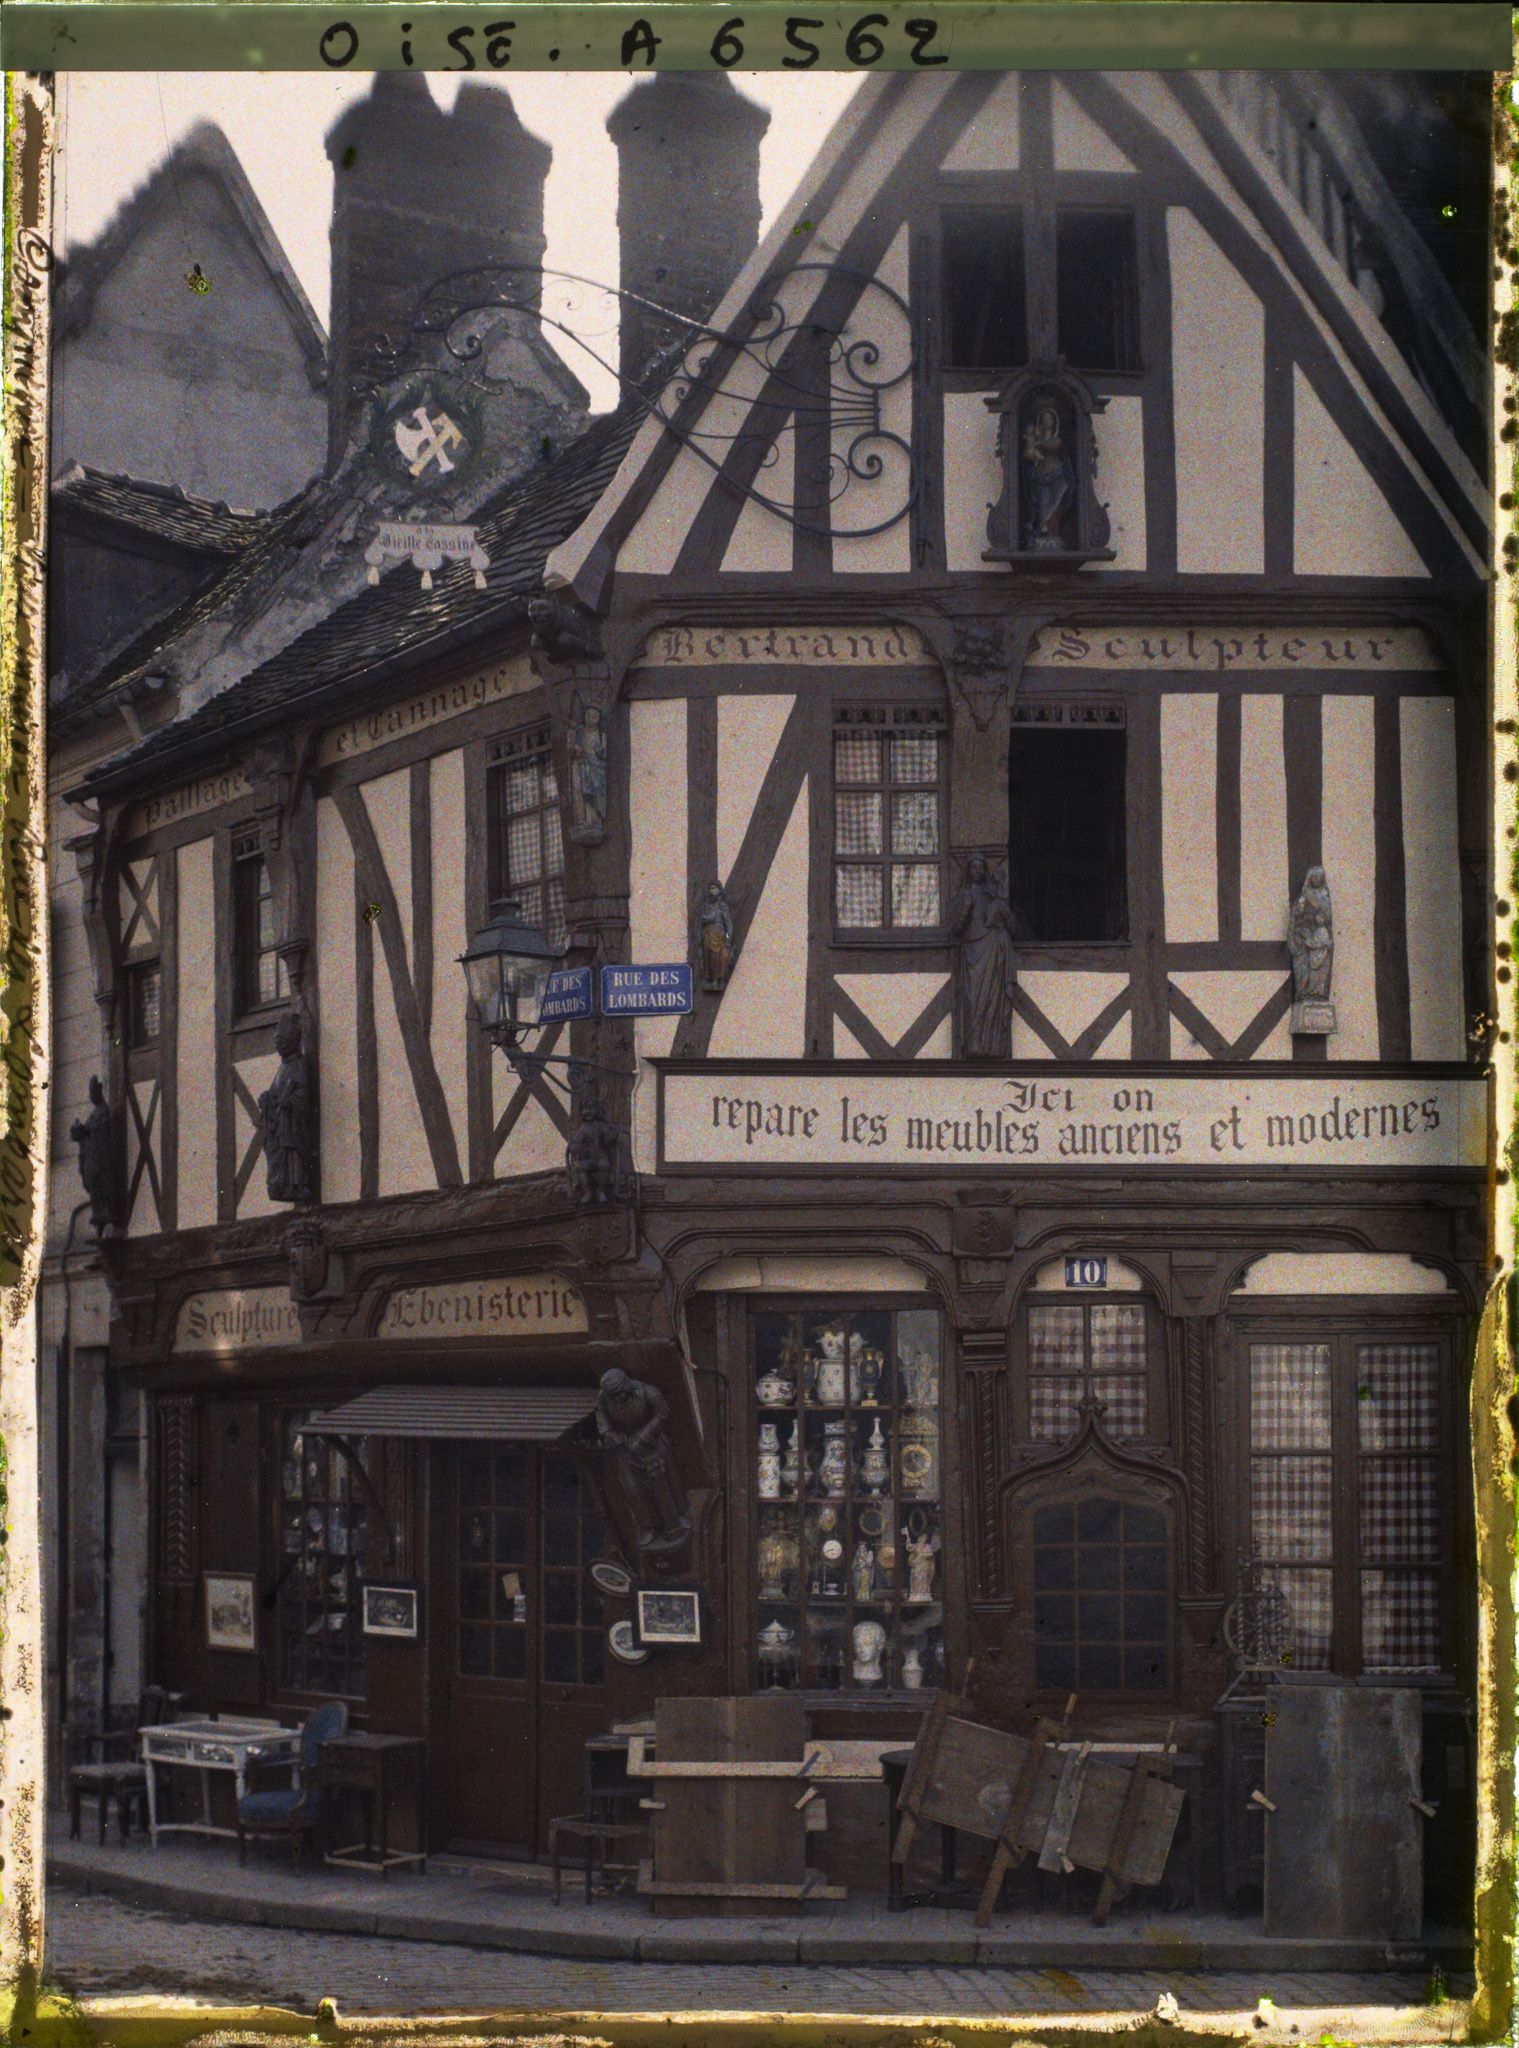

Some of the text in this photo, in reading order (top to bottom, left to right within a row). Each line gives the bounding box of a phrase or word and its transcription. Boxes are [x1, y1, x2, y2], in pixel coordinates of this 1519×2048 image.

[662, 626, 909, 663] Bertrand
[1051, 624, 1395, 669] Sculpteur
[335, 721, 359, 754] et
[562, 974, 582, 990] DES
[613, 970, 680, 987] RUE DES
[609, 991, 686, 1009] LOMBARDS
[1002, 1079, 1154, 1115] Ici on
[711, 1094, 1442, 1156] repare les meubles anciens et modernes
[1072, 1260, 1101, 1284] 10
